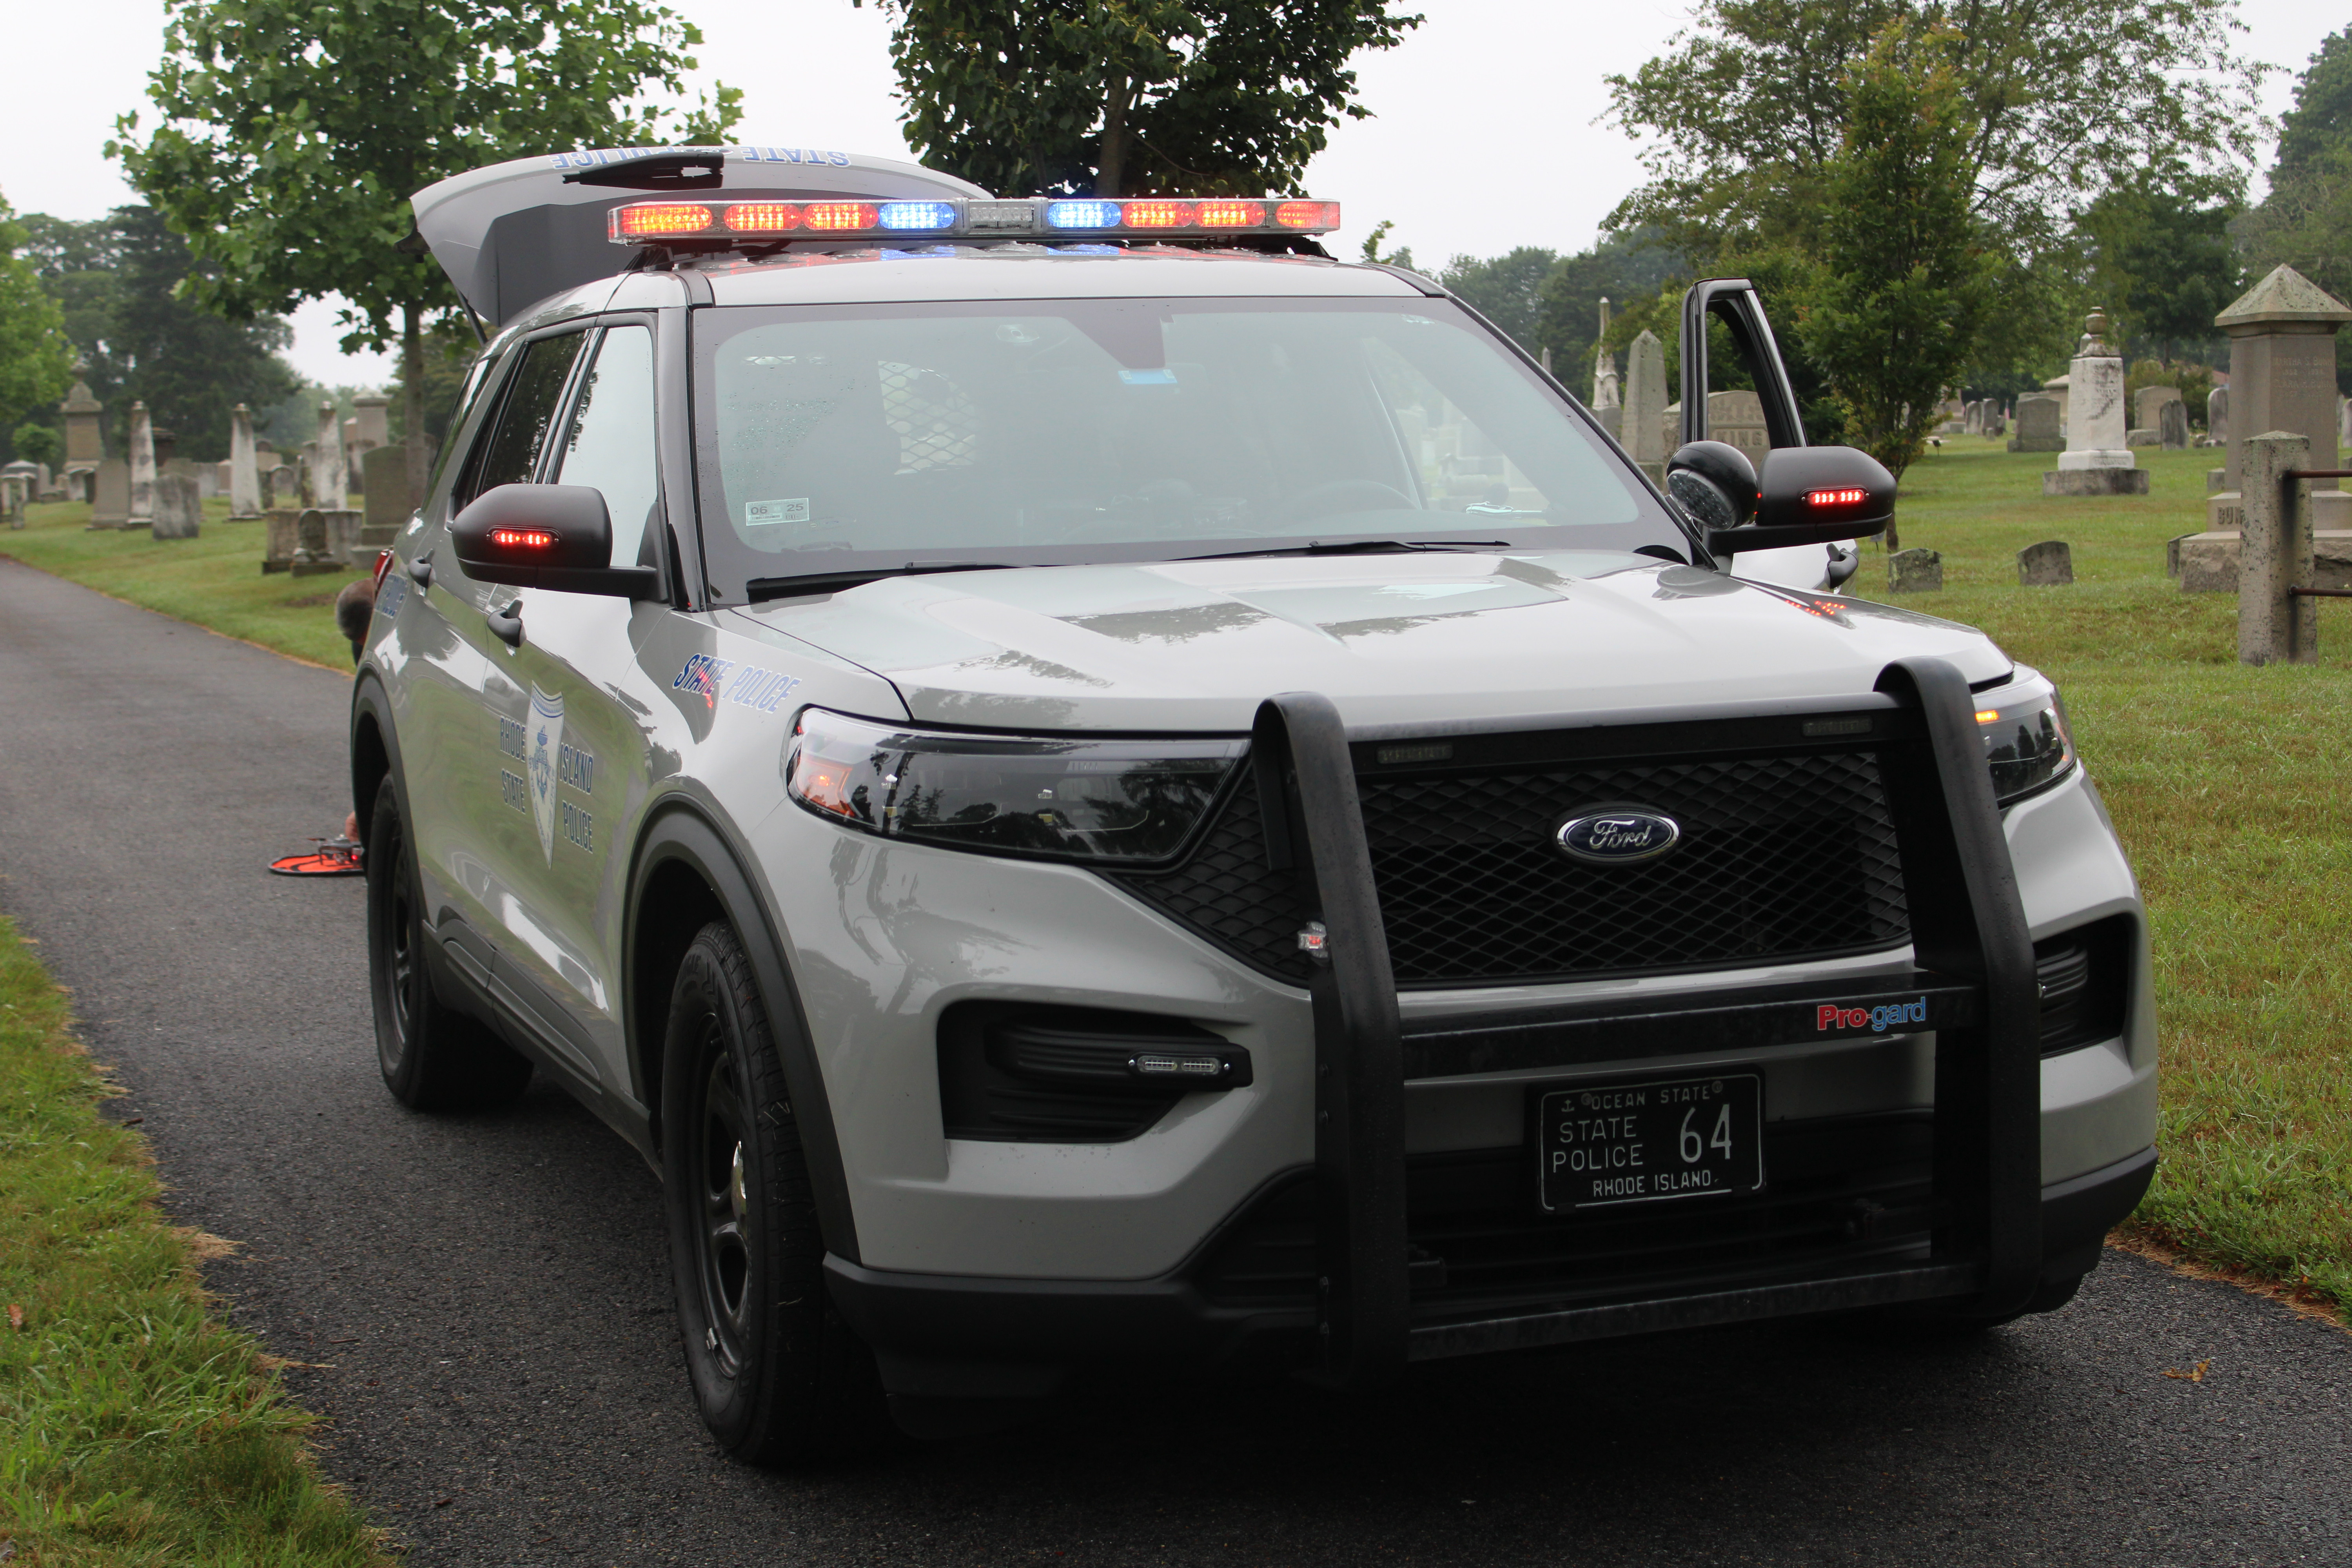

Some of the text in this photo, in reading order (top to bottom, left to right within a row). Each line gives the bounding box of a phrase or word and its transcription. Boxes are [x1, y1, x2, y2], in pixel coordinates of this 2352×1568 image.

[739, 147, 851, 167] STATE
[1717, 431, 1762, 446] KING
[751, 503, 804, 515] 06 25
[2217, 506, 2242, 524] BUN
[672, 653, 802, 714] STATE POLICE
[500, 715, 594, 795] RHODE ISLAND
[501, 768, 526, 815] STATE
[562, 799, 593, 854] POLICE
[1589, 819, 1651, 849] Ford
[1817, 996, 1926, 1031] Pro-gard
[1591, 1085, 1710, 1110] OCEAN STATE
[1559, 1116, 1637, 1143] STATE
[1679, 1103, 1732, 1163] 64
[1553, 1144, 1643, 1173] POLICE
[1593, 1170, 1711, 1197] RHODE ISLAND
